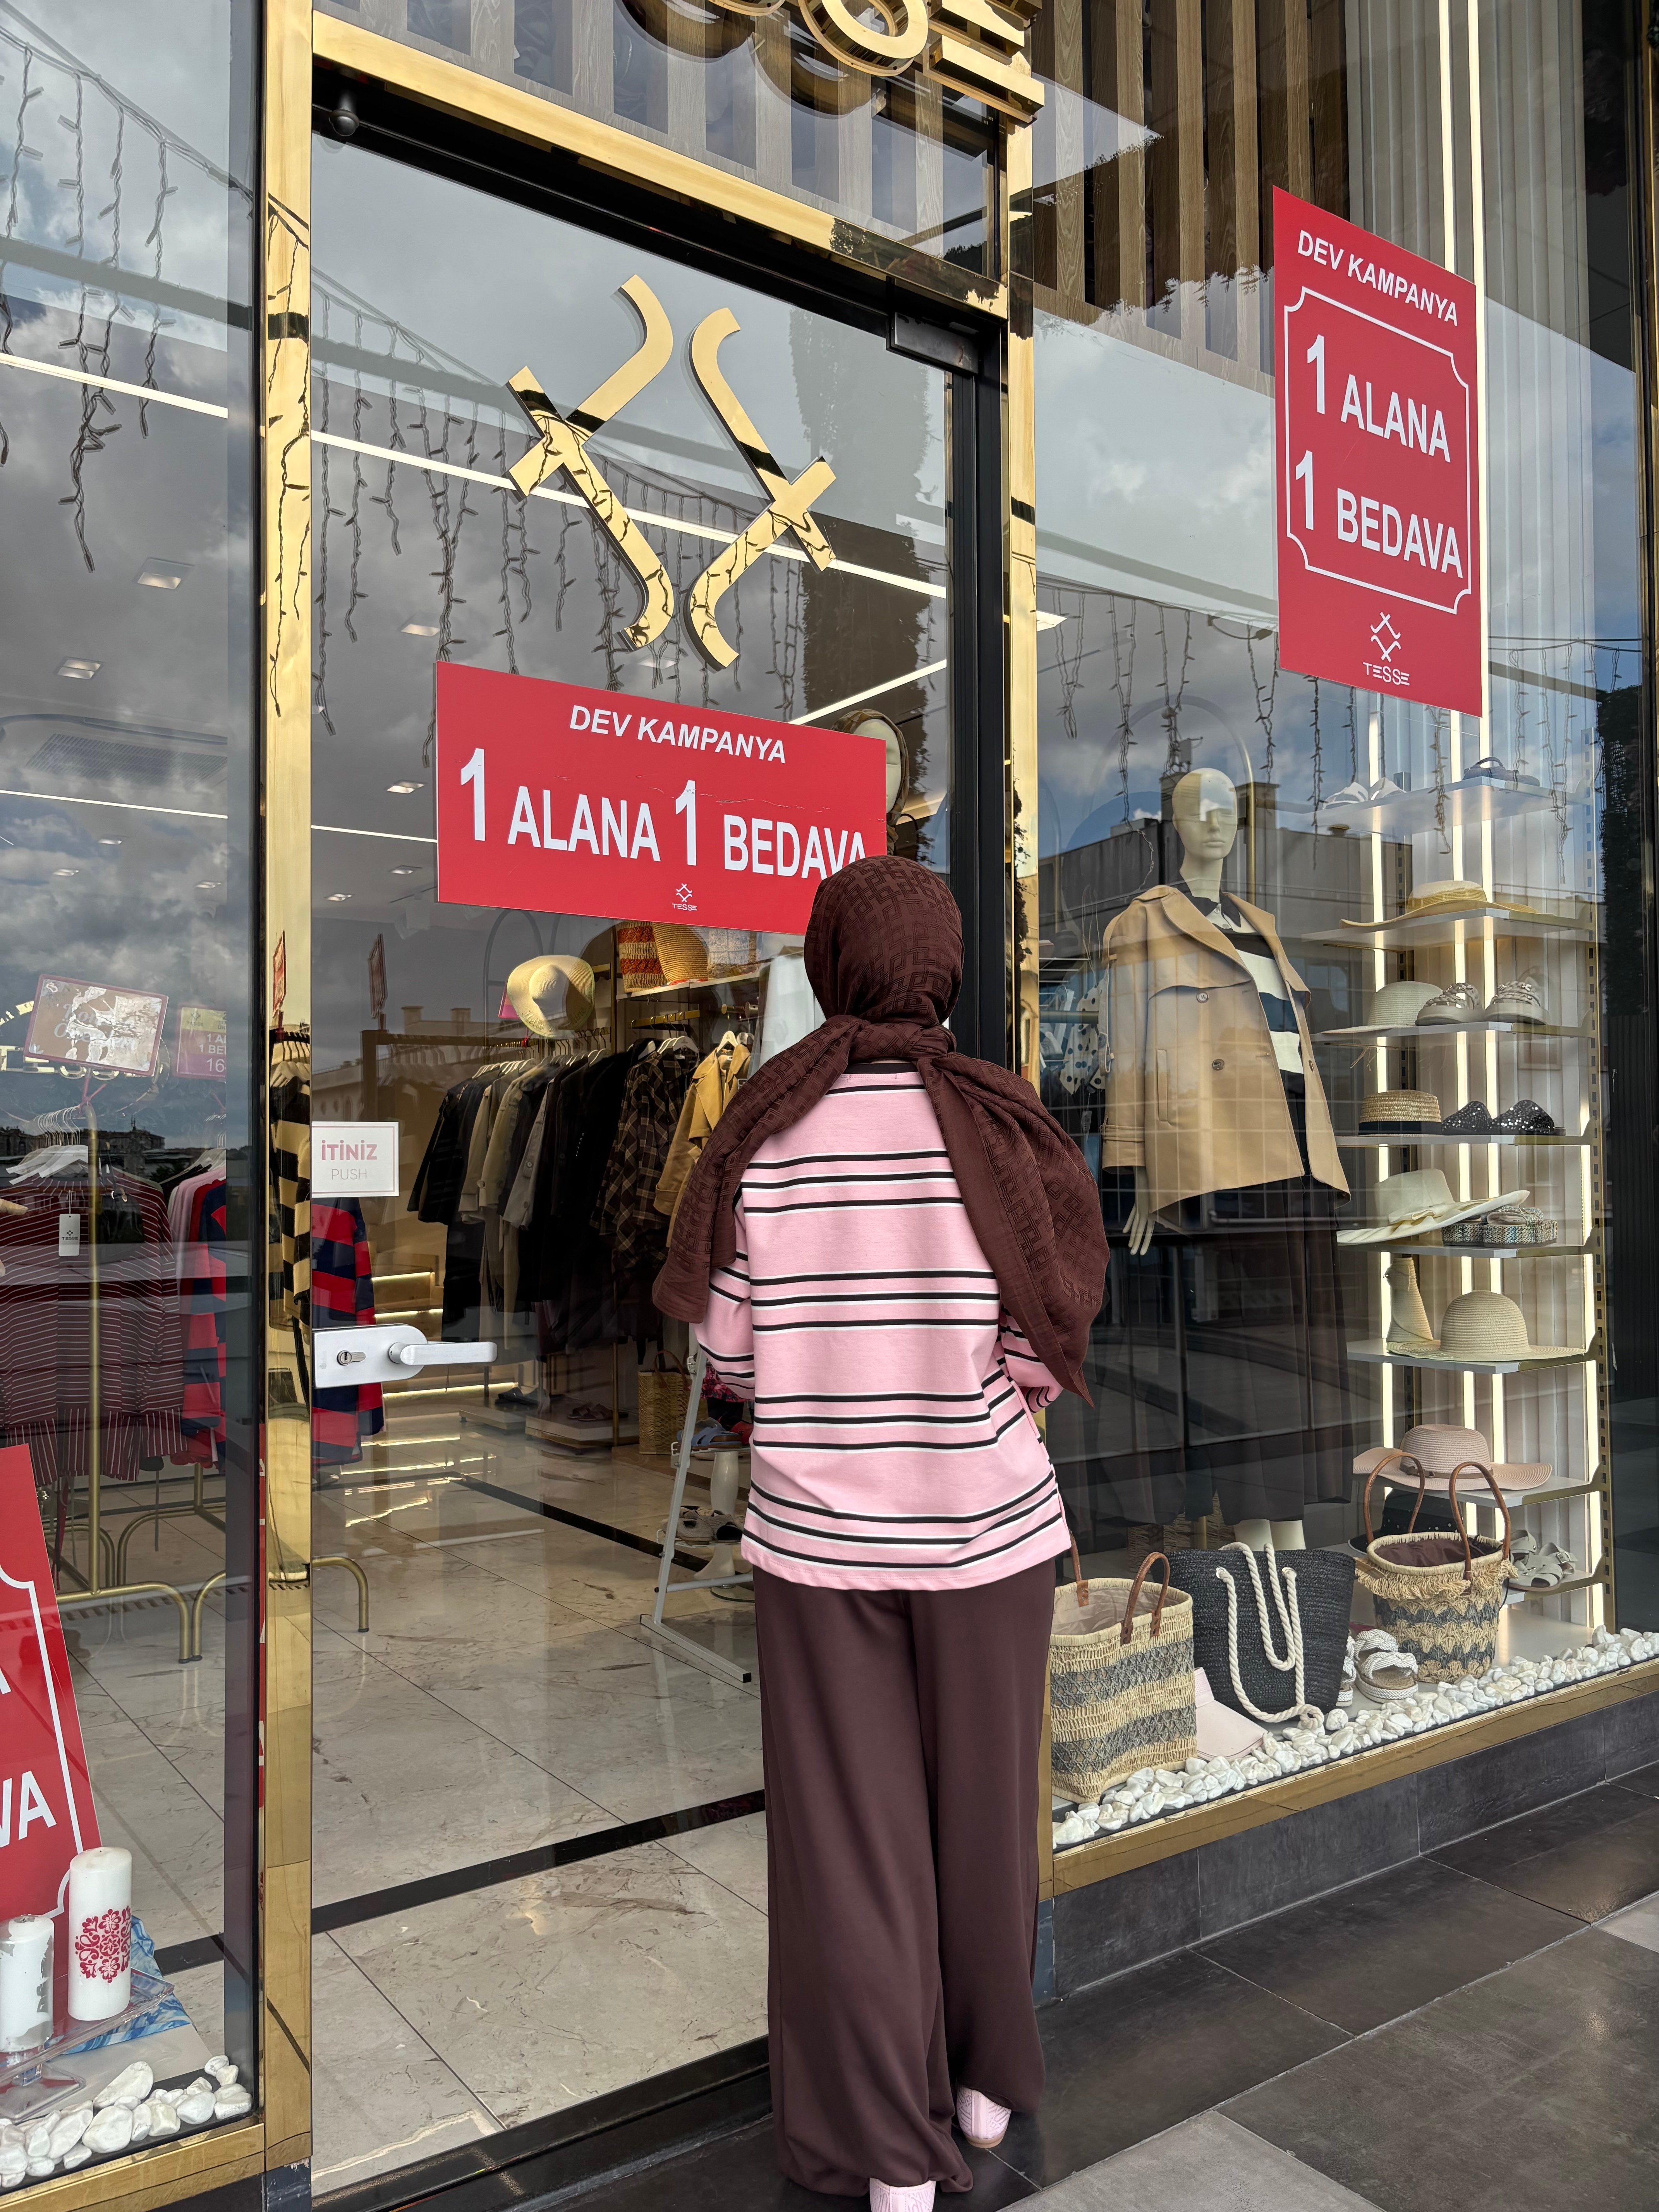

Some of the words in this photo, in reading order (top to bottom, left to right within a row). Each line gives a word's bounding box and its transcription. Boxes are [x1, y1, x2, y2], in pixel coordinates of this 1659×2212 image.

[1298, 230, 1344, 270] DEV
[1348, 253, 1458, 326] KAMPANYA
[1307, 334, 1325, 415] 1
[1340, 374, 1451, 463] ALANA
[1295, 450, 1314, 531] 1
[1337, 488, 1463, 579] BEDAVA
[1363, 662, 1410, 686] TESSE
[570, 705, 632, 737] DEV
[637, 716, 786, 764] KAMPANYA
[461, 748, 486, 841] 1
[507, 785, 661, 862] ALANA
[675, 780, 697, 866] 1
[672, 903, 697, 911] TESSE
[199, 1044, 203, 1053] 1
[207, 1034, 211, 1042] 1
[207, 1058, 227, 1073] 16
[321, 1139, 378, 1160] İTİNİZ
[331, 1168, 367, 1180] PUSH
